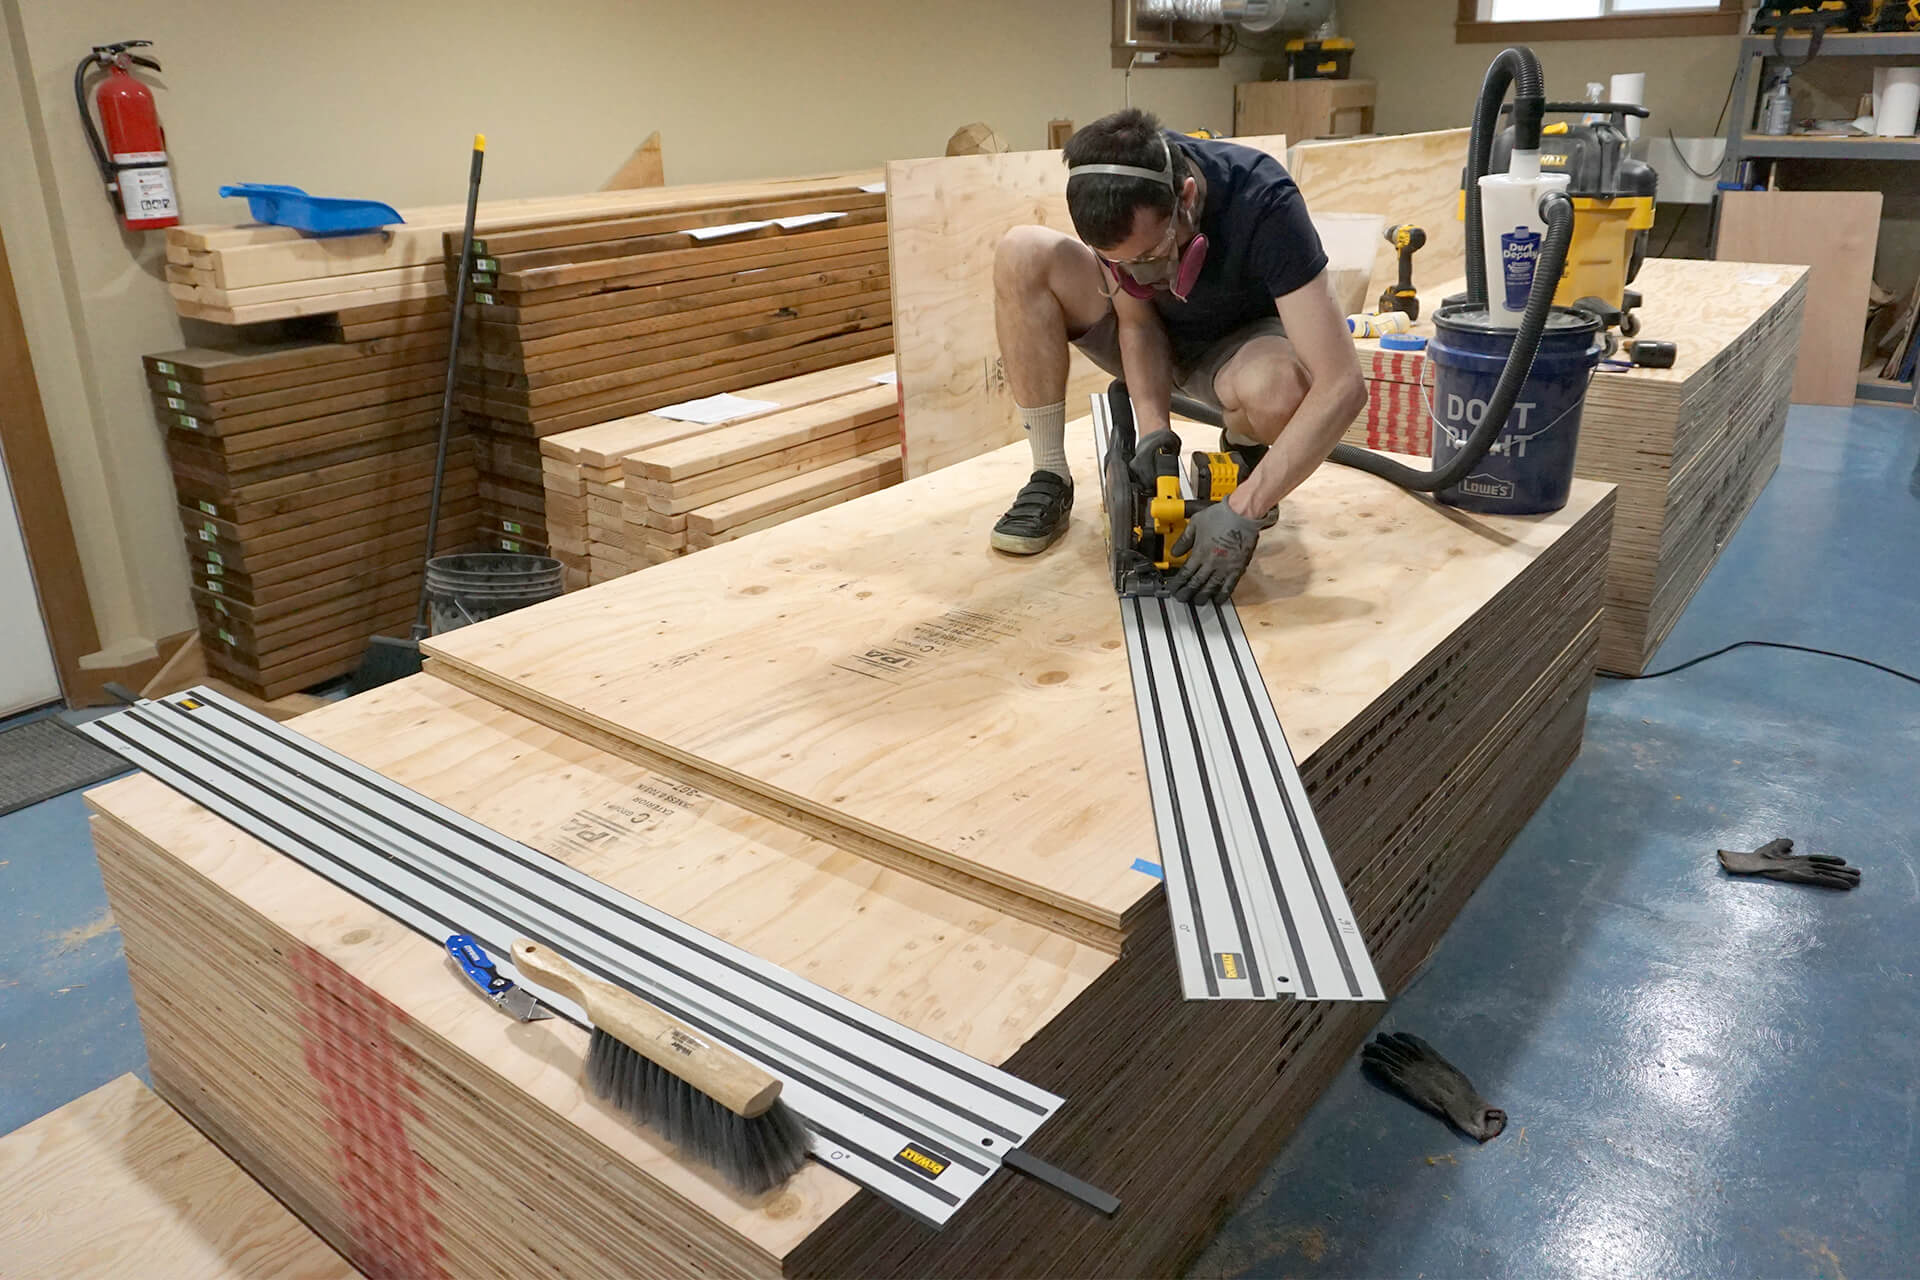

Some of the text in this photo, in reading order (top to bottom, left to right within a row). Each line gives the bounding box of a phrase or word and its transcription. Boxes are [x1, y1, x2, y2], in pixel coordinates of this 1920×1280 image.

[1503, 249, 1538, 260] Deputy
[1509, 242, 1534, 252] Dust
[1447, 393, 1488, 426] DO
[1463, 479, 1508, 496] LOWE'S
[632, 796, 675, 816] EXTERIOR
[900, 1147, 945, 1175] DEWALT
